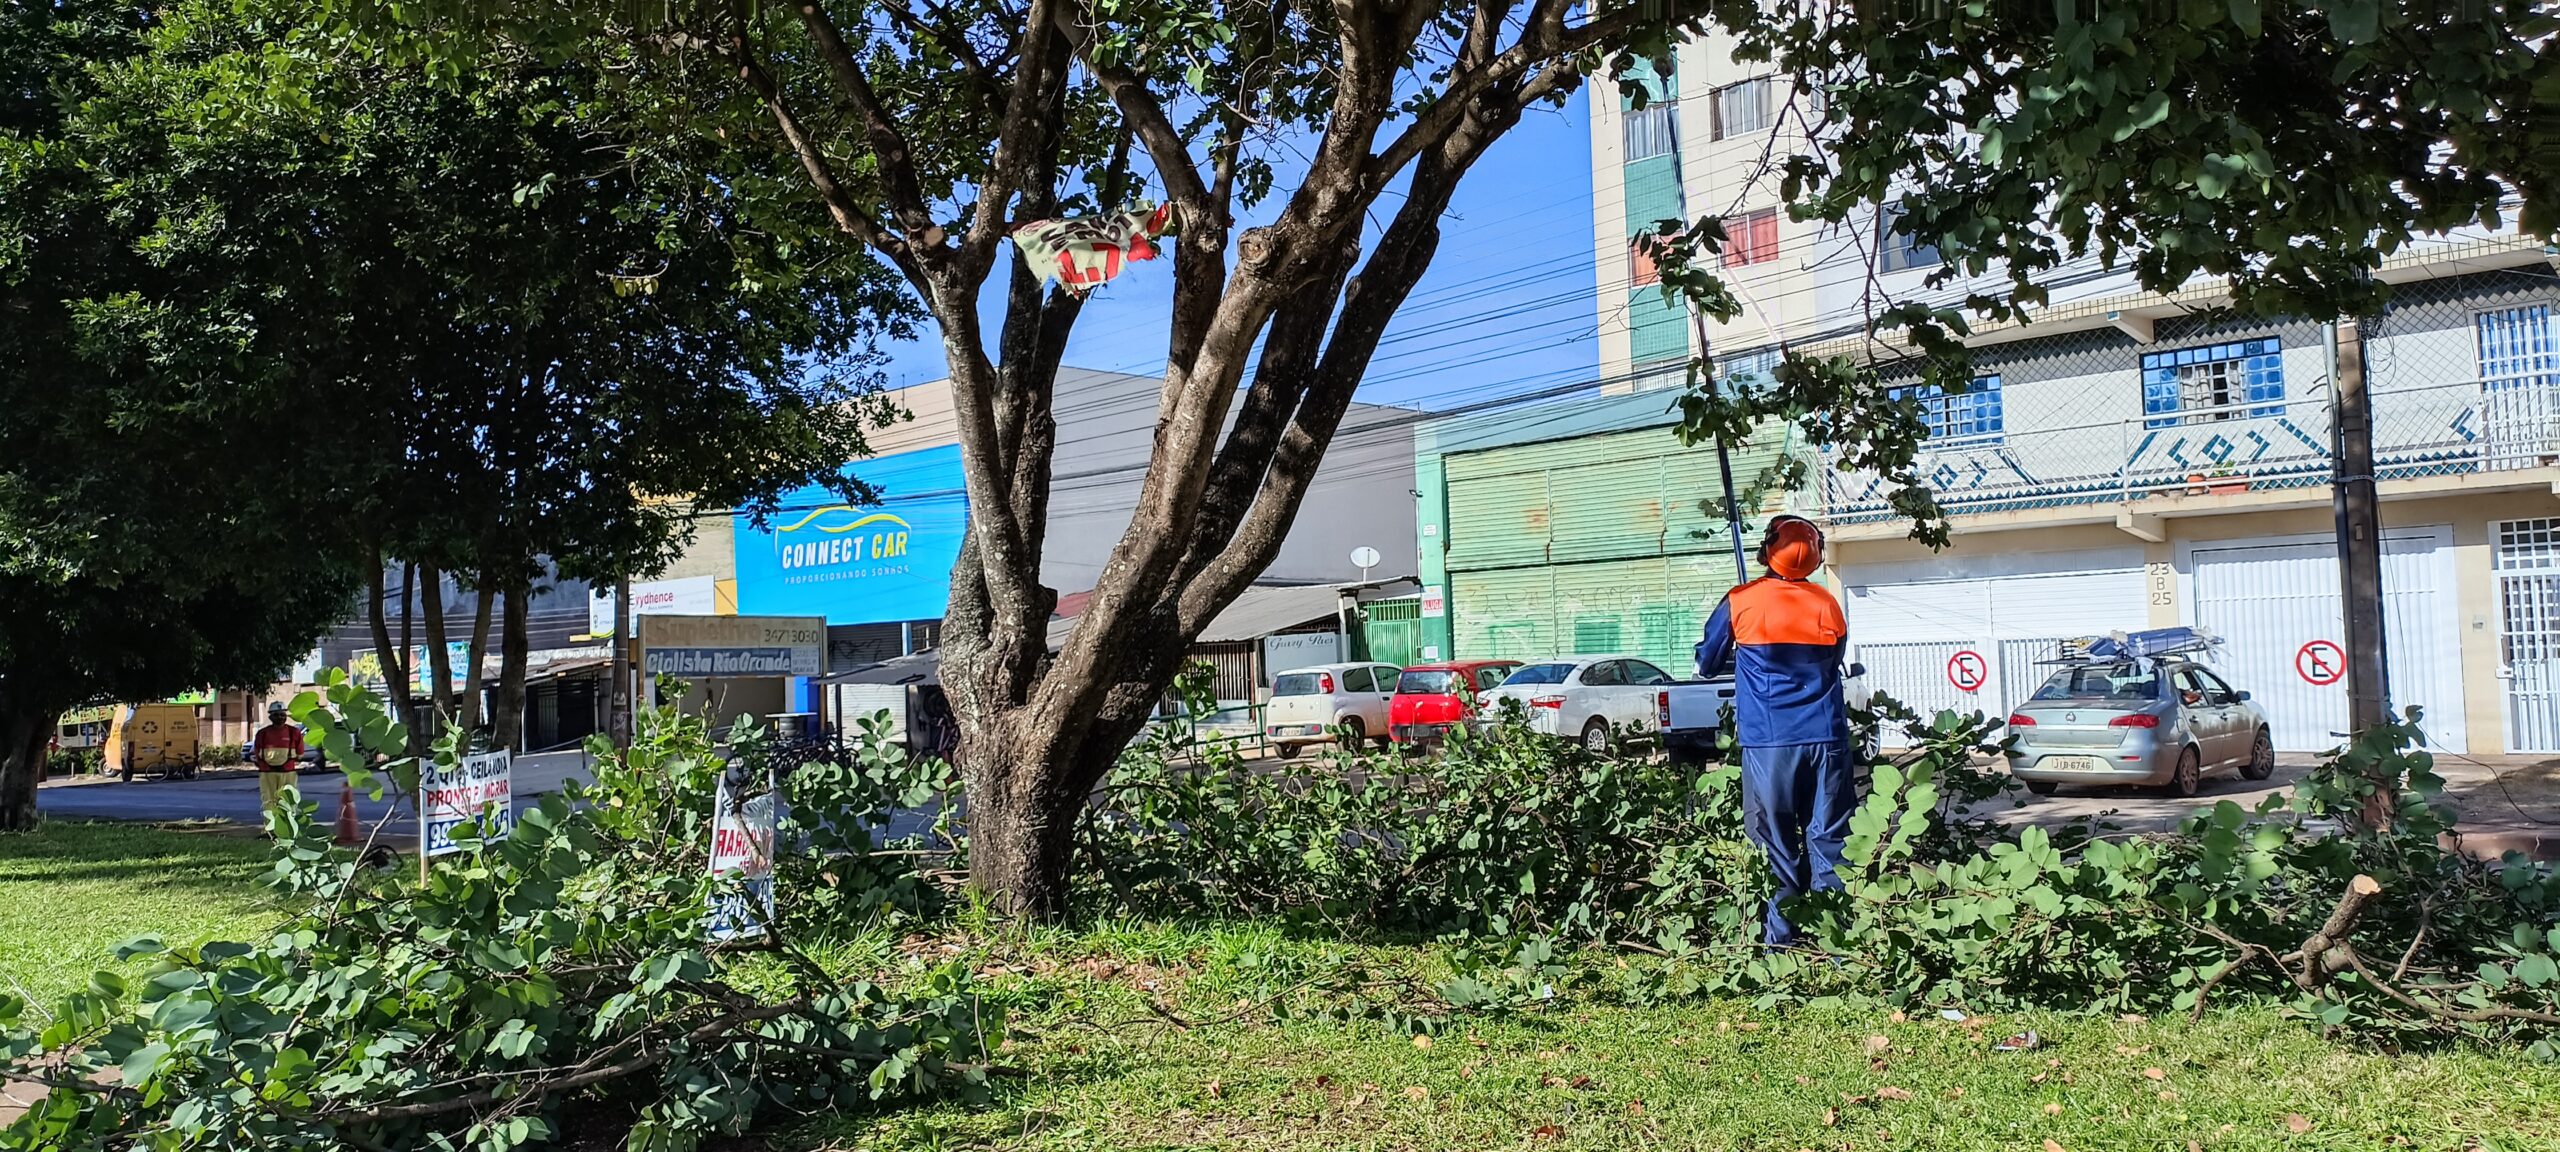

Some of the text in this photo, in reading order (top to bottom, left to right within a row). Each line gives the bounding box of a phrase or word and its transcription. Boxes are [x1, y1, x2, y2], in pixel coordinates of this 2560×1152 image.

[782, 532, 908, 569] CONNECT CAR
[784, 566, 909, 585] PROPORCIONANDO SONHOS
[2150, 561, 2170, 575] 23
[1423, 599, 1443, 610] ALUGA
[2152, 592, 2171, 605] 25
[1960, 657, 1973, 684] E
[2312, 647, 2329, 677] E
[426, 766, 435, 785] 2
[427, 786, 472, 808] PRONTO
[484, 779, 509, 799] MORAR
